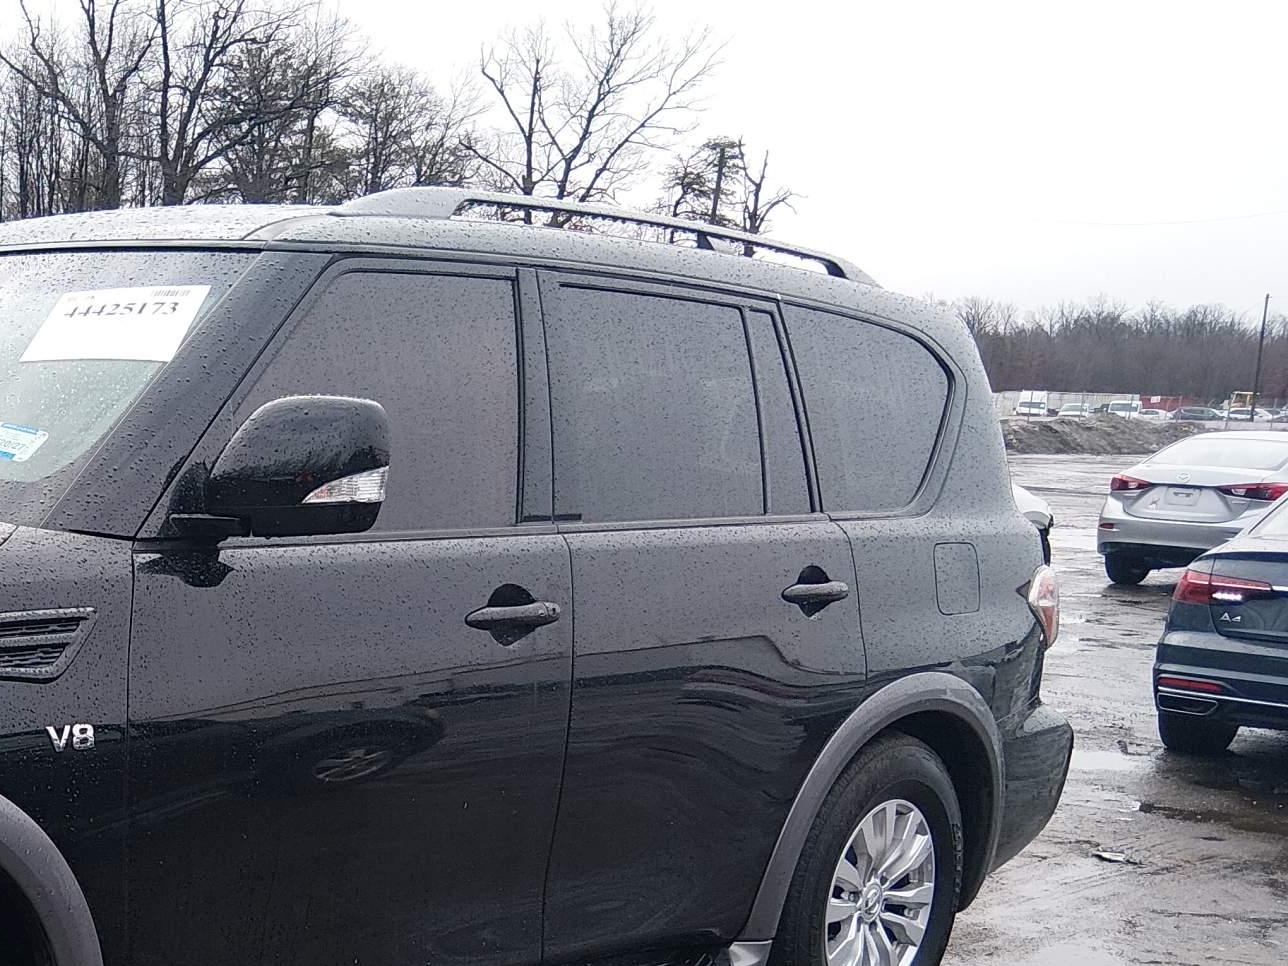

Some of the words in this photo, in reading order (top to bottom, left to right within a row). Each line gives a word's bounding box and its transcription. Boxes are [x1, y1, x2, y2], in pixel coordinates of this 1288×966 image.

[63, 301, 180, 318] 44425173
[1219, 612, 1242, 622] A4
[45, 723, 95, 752] V8
